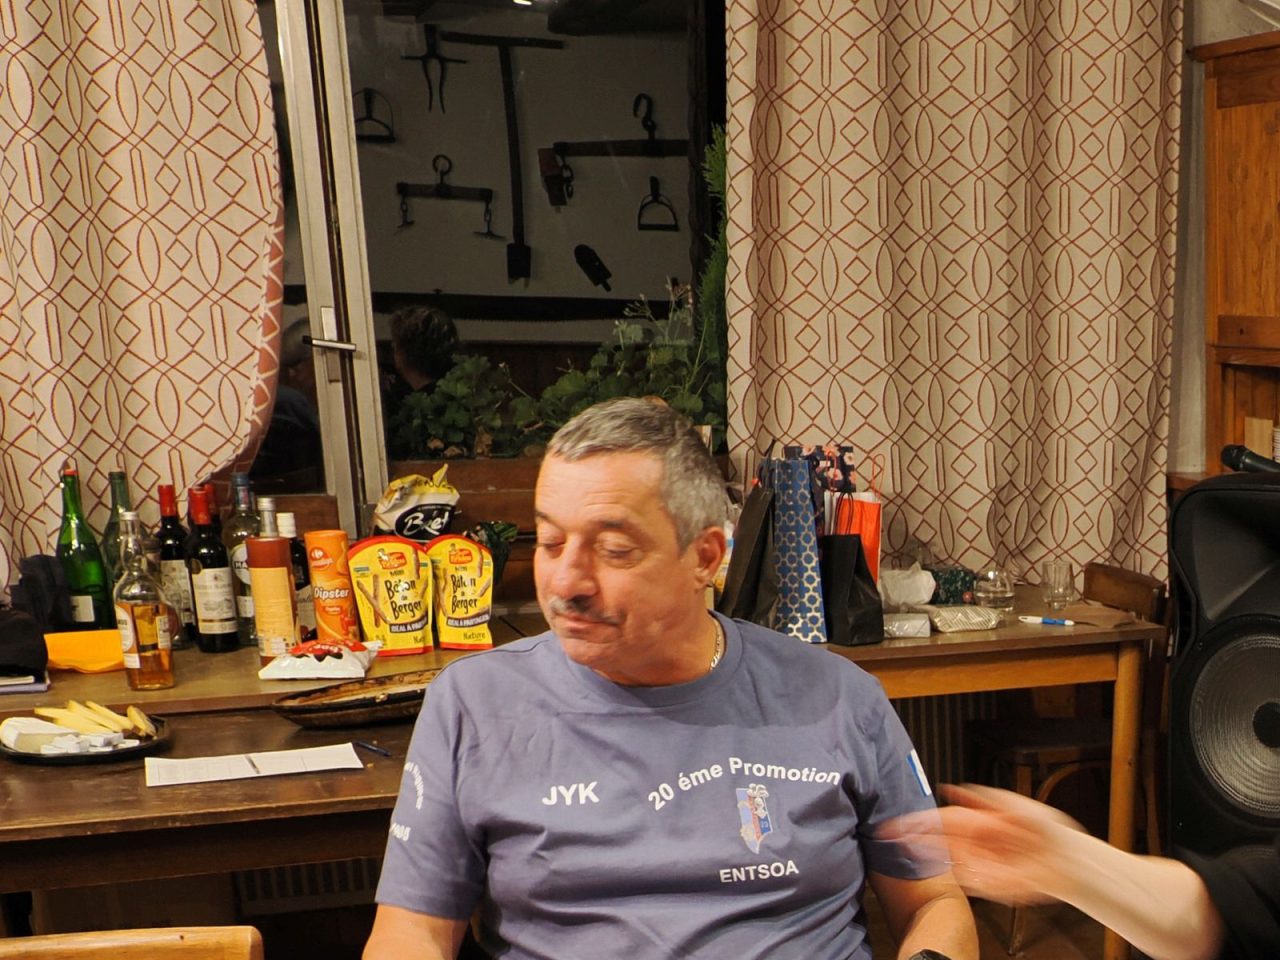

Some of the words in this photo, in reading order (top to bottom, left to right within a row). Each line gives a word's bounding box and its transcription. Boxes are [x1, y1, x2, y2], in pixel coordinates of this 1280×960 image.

[313, 587, 350, 601] Dipster
[451, 595, 478, 614] Berger
[389, 600, 423, 620] Berger
[541, 781, 600, 806] JYK
[648, 783, 675, 811] 20
[678, 764, 724, 791] éme
[728, 757, 841, 785] Promotion
[719, 860, 799, 883] ENTSOA
